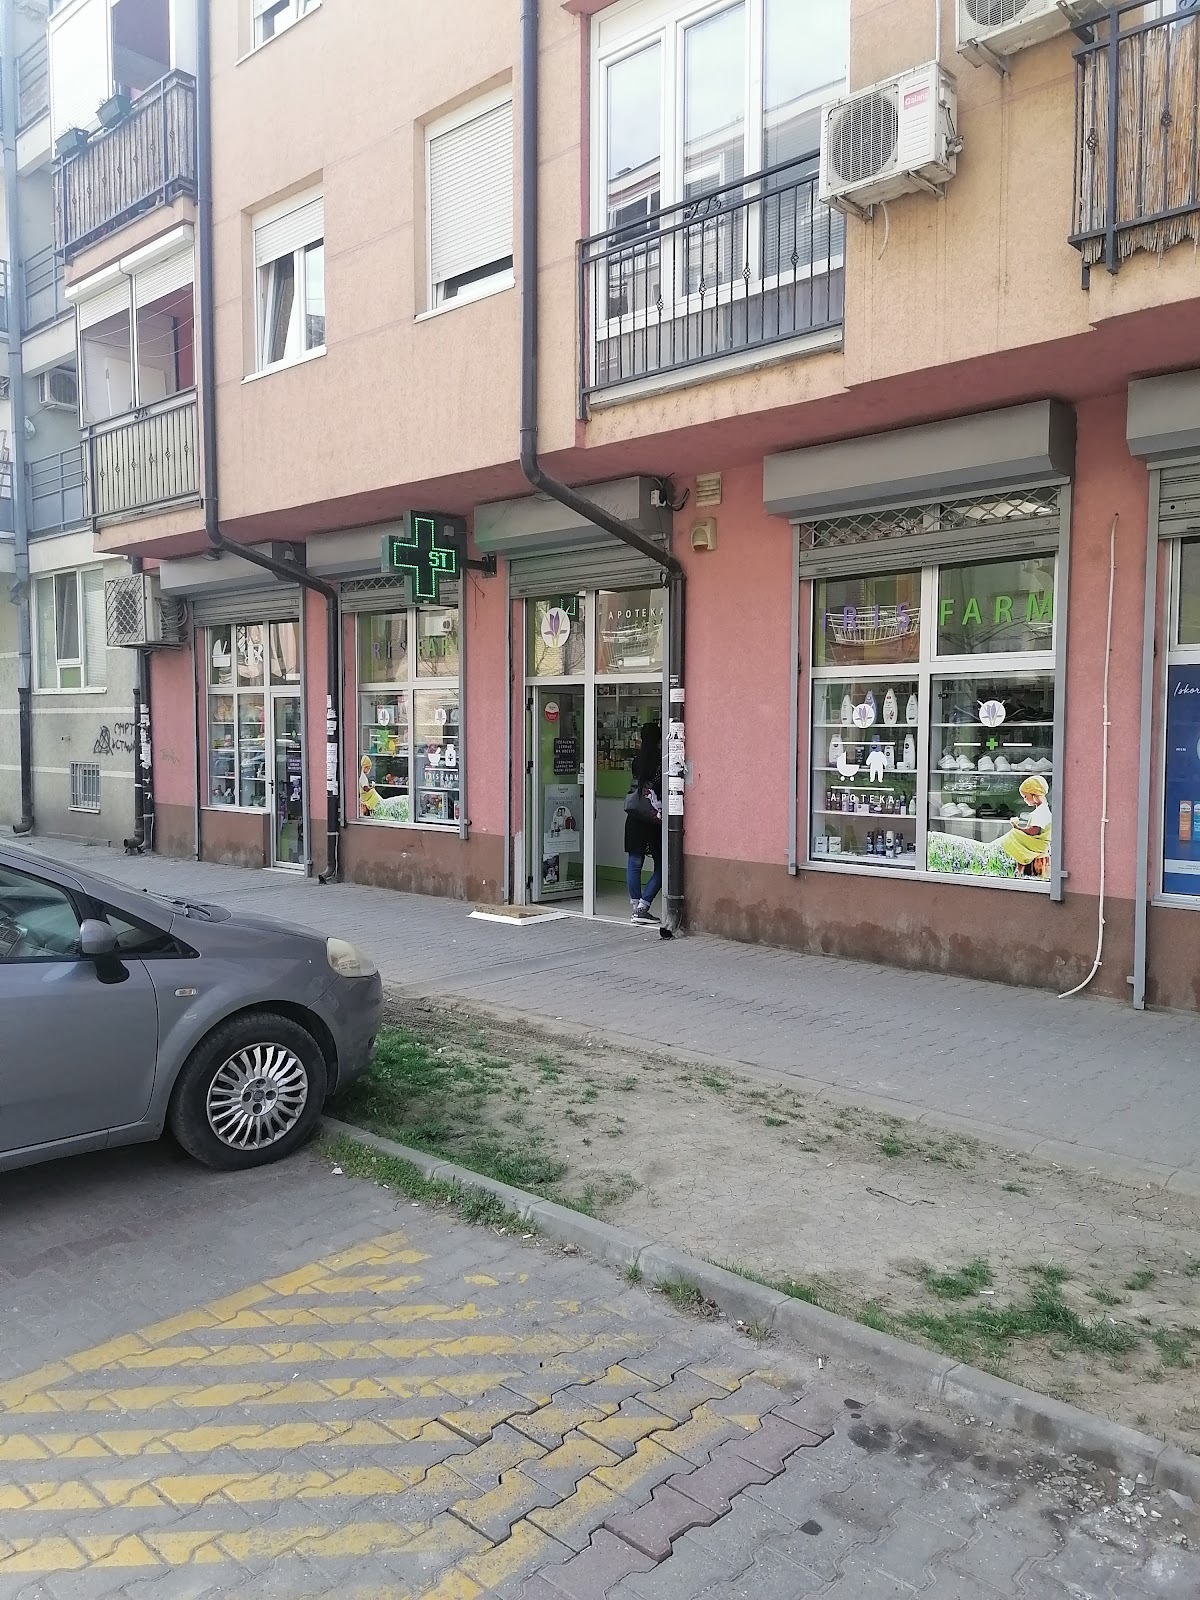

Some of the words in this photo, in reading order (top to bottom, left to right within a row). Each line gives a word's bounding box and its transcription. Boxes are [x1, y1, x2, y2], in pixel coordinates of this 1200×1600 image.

[608, 607, 664, 620] APOTEKA
[822, 602, 910, 633] IRIS
[940, 591, 1053, 626] FARM
[830, 793, 895, 804] APOTEKA
